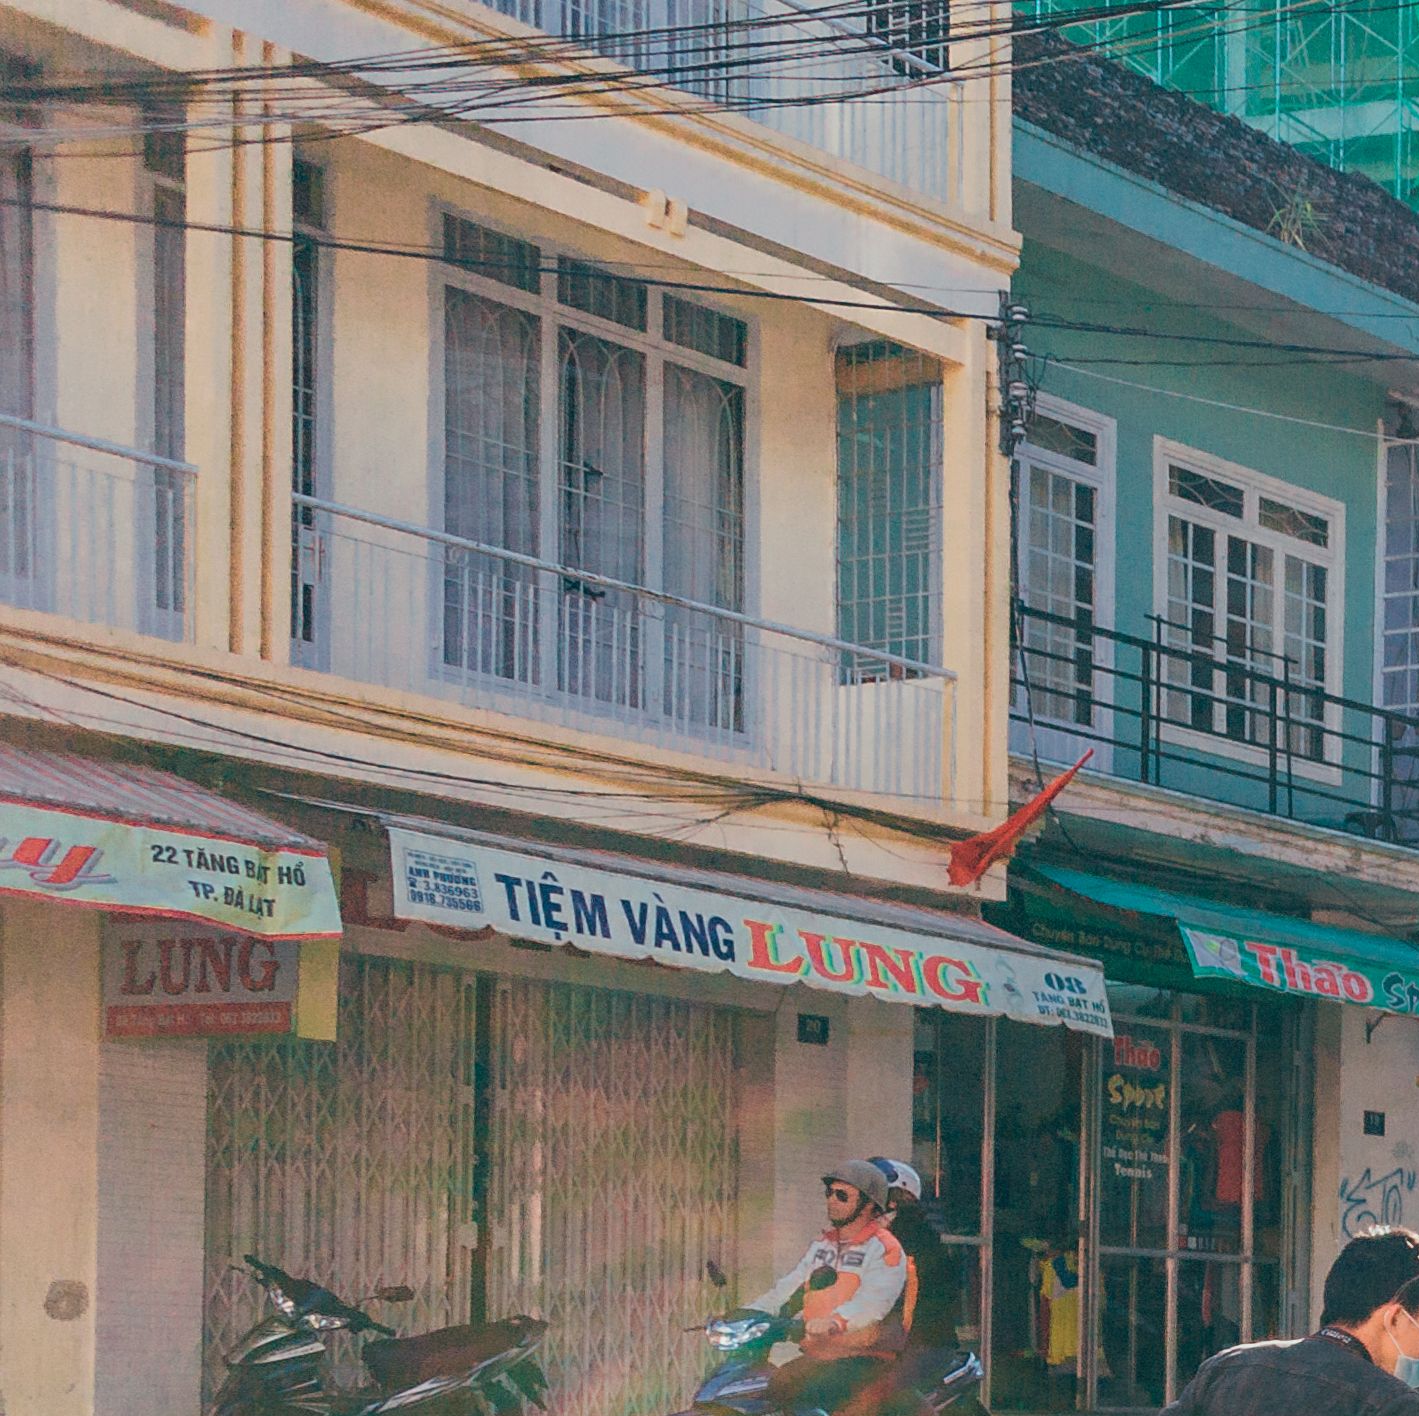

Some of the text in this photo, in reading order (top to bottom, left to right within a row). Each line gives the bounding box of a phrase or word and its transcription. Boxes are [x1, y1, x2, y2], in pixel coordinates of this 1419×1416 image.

[152, 844, 179, 864] 22
[184, 847, 241, 875] TĂNG
[277, 862, 306, 887] HỔ
[189, 880, 219, 902] TP.
[224, 886, 245, 911] ĐÀ
[494, 870, 612, 941] TIỆM
[620, 892, 736, 964] VÀNG
[743, 919, 990, 1005] LUNG
[118, 936, 281, 997] LUNG
[1044, 972, 1088, 995] 08
[1245, 941, 1374, 1004] Thảo
[1107, 1073, 1166, 1113] Sport
